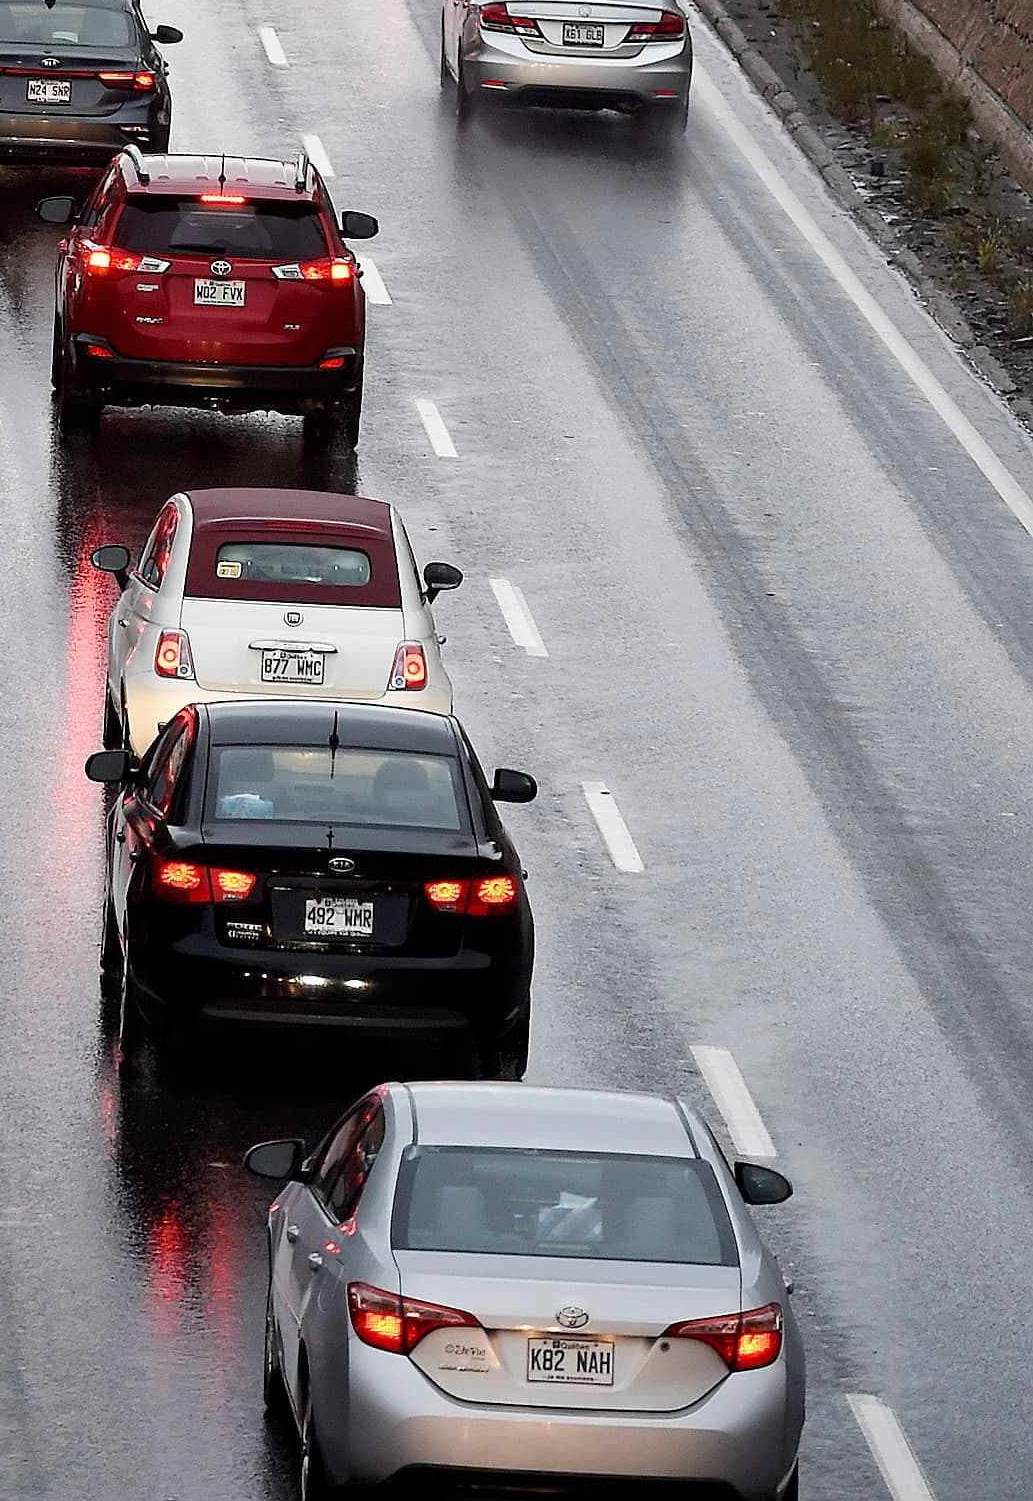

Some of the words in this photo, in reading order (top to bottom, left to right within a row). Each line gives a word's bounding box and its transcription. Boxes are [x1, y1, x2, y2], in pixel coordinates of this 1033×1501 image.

[222, 286, 243, 301] FVX
[297, 659, 322, 676] WMC
[307, 906, 335, 926] 492
[344, 908, 372, 927] WMR
[530, 1348, 566, 1373] K82
[576, 1350, 611, 1375] NAH
